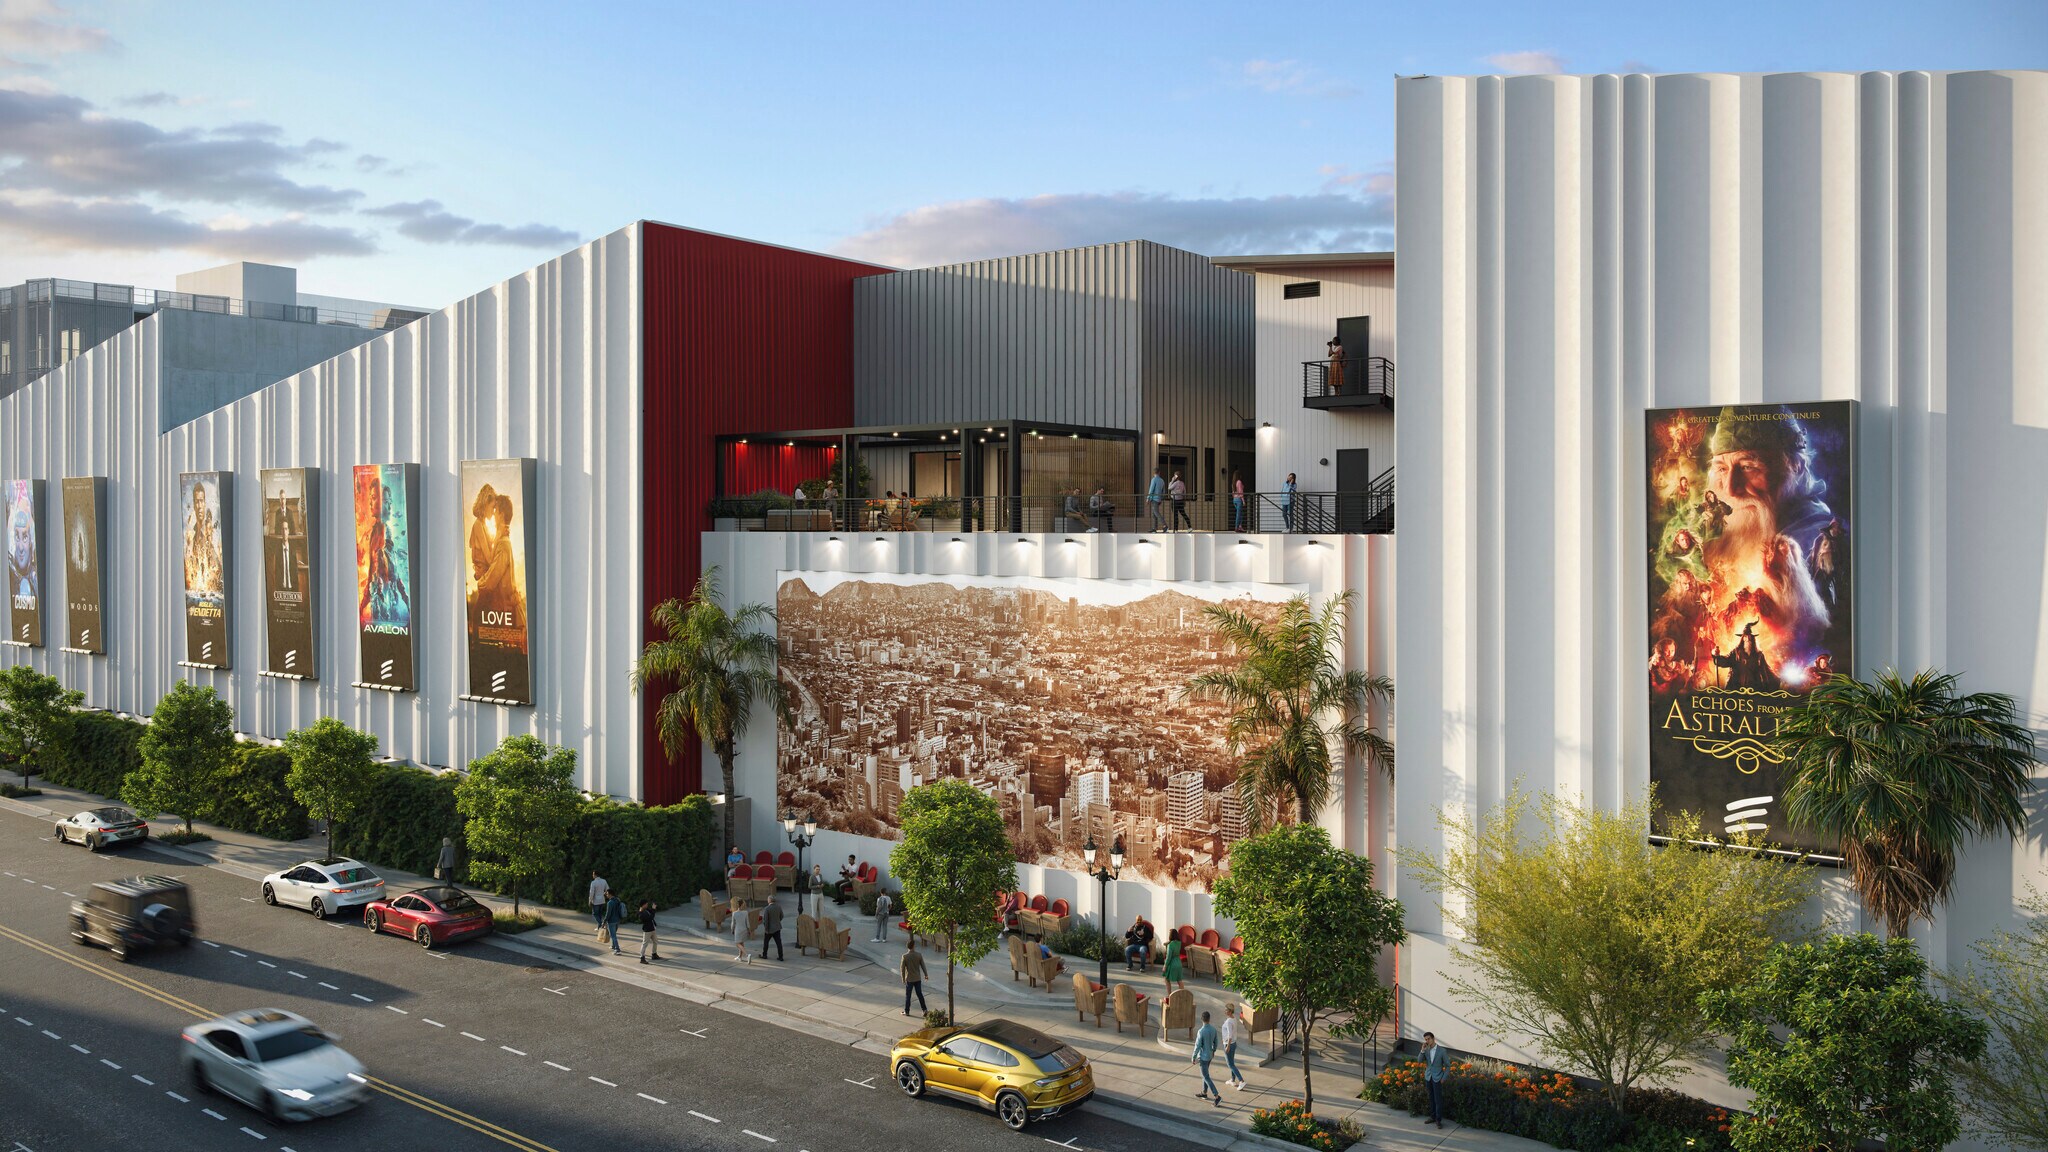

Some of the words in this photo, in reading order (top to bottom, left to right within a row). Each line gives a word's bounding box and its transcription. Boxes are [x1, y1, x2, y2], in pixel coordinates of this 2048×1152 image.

[1726, 413, 1771, 422] ADVENTURE
[1772, 412, 1821, 421] CONTINUES
[14, 595, 36, 610] COSMO
[70, 602, 98, 612] WOODS
[189, 606, 221, 618] VENDETTA
[481, 610, 513, 626] LOVE
[363, 624, 409, 636] AVALON
[1691, 695, 1754, 713] ECHOES
[1757, 705, 1784, 714] FROM
[1661, 698, 1768, 737] ASTRAL
